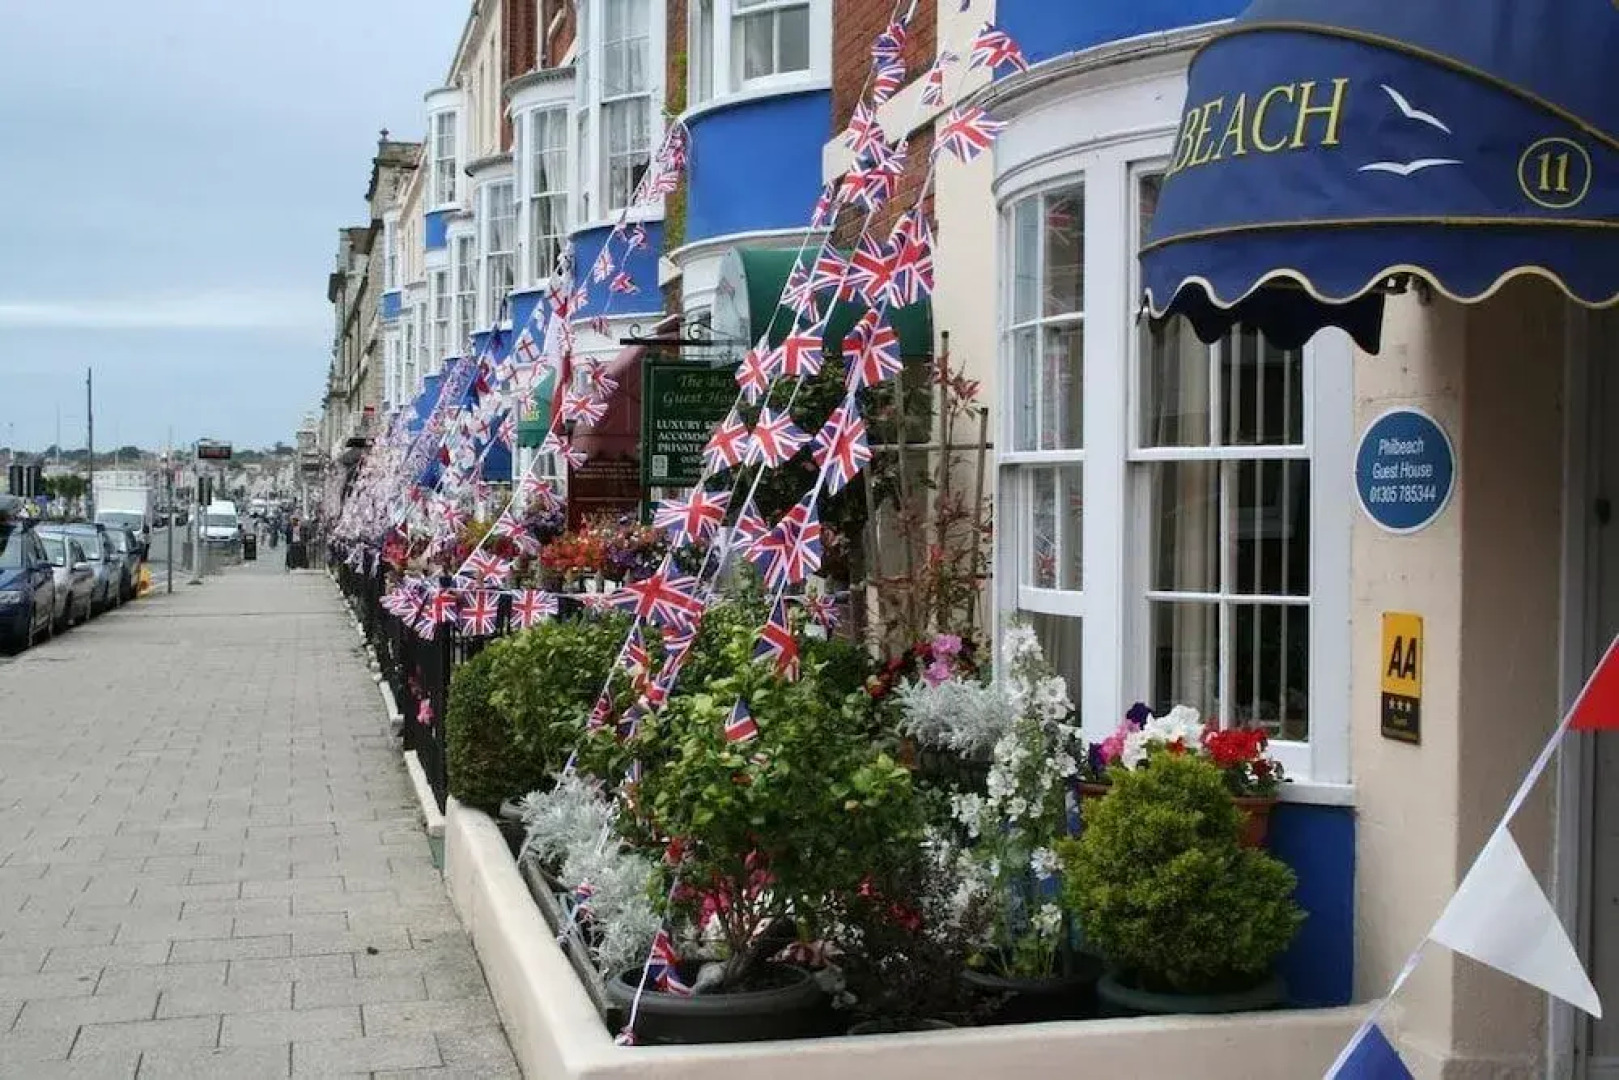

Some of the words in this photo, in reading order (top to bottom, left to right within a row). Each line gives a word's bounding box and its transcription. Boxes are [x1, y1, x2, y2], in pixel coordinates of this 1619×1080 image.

[1165, 77, 1348, 179] BEACH
[1536, 151, 1571, 192] 11
[677, 374, 703, 387] The
[663, 391, 702, 408] Guest
[705, 391, 737, 405] Hou
[656, 419, 702, 430] LUXURY
[657, 443, 702, 453] PRIVATE
[1378, 438, 1424, 455] Philbeach
[1373, 463, 1398, 479] Guest
[1400, 461, 1432, 478] House
[1370, 486, 1398, 502] 01305
[1399, 485, 1436, 502] 785344
[1387, 635, 1417, 681] AA
